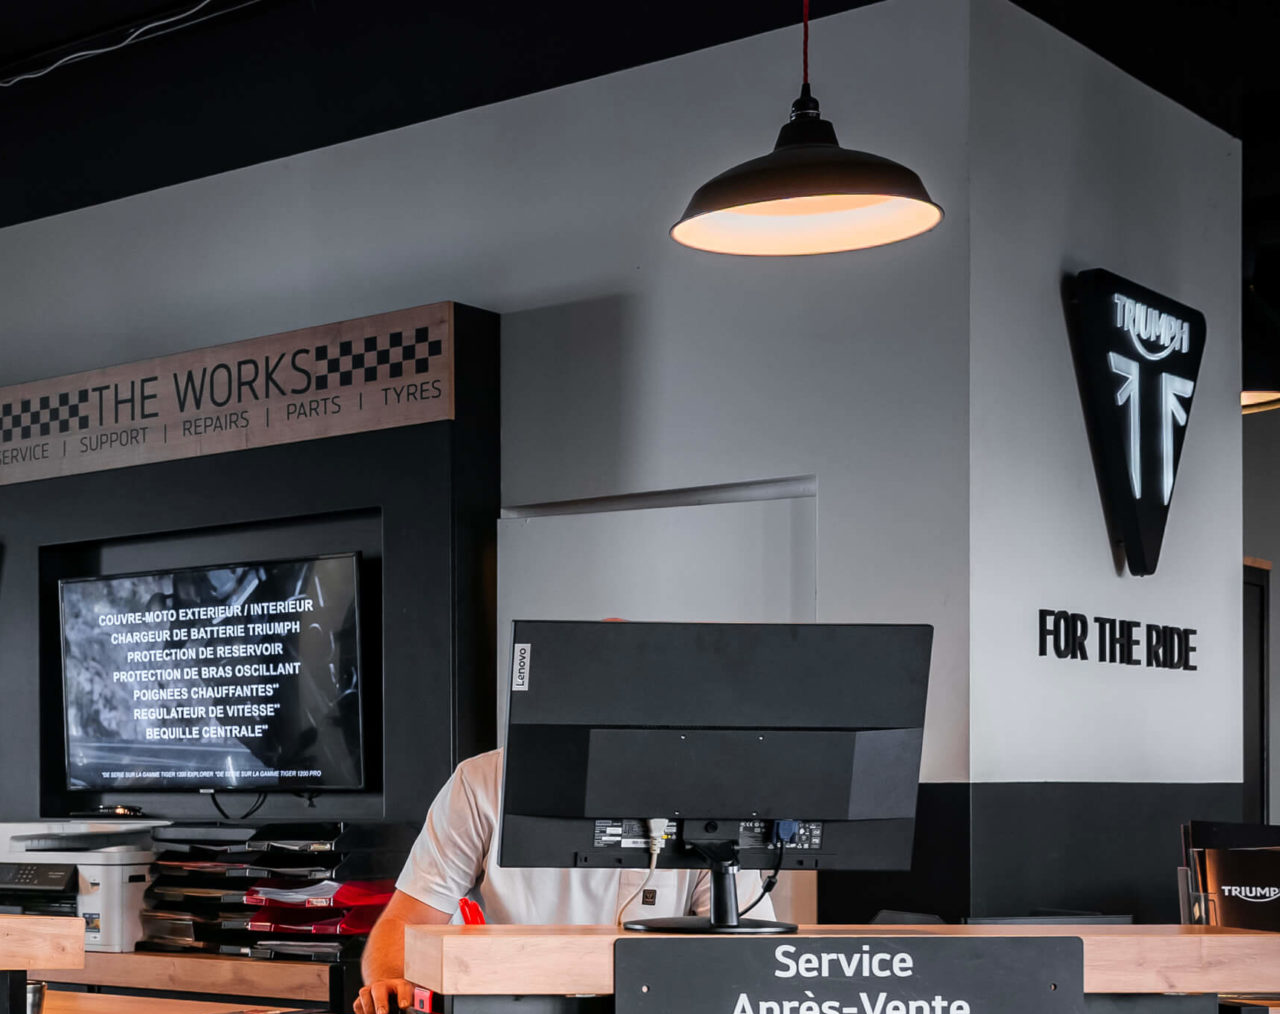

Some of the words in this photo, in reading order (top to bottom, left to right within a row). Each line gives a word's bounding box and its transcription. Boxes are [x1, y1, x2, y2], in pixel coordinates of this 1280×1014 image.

[1114, 293, 1190, 360] TRIUMPH
[91, 376, 159, 427] THE
[173, 348, 312, 413] WORKS
[80, 427, 149, 453] SUPPORT
[183, 411, 249, 436] REPAIRS
[287, 396, 341, 421] PARTS
[381, 380, 442, 405] TYRES
[98, 609, 177, 626] COUVRE-MOTO
[179, 605, 242, 621] EXTERIEUR
[250, 599, 314, 616] INTERIEUR
[111, 630, 171, 645] CHARGEUR
[173, 628, 188, 641] DE
[190, 625, 245, 640] BATTERIE
[247, 621, 300, 636] TRIUMPH
[1038, 609, 1088, 660] FOR
[1093, 616, 1141, 666] THE
[1146, 624, 1198, 671] RIDE
[127, 648, 196, 663] PROTECTION
[199, 647, 214, 659] DE
[217, 643, 283, 658] RESERVOIR
[113, 668, 181, 683] PROTECTION
[184, 667, 199, 680] DE
[201, 665, 233, 679] BRAS
[235, 662, 301, 677] OSCILLANT
[515, 647, 527, 687] Lenovo
[133, 688, 188, 701] POIGNEES
[133, 706, 206, 720] REGULATEUR
[208, 705, 224, 718] DE
[146, 727, 200, 740] BEQUILLE
[1221, 885, 1280, 902] TRIUMP
[774, 944, 914, 978] Service
